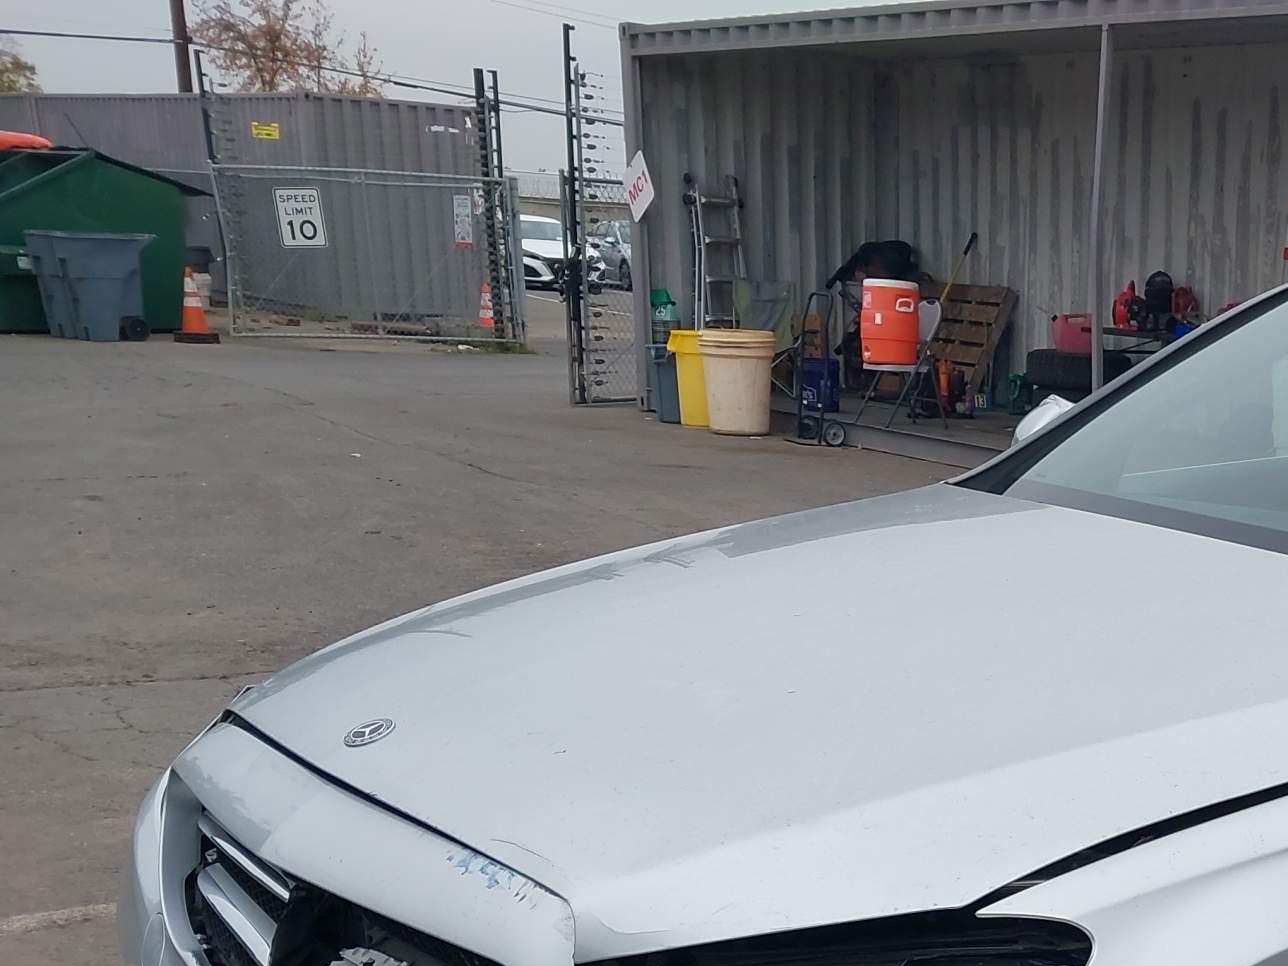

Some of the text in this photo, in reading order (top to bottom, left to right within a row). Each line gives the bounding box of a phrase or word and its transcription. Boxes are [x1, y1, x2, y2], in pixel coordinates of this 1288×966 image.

[628, 170, 648, 206] MC1
[279, 194, 316, 203] SPEED
[284, 206, 313, 216] LIMIT
[287, 219, 318, 241] 10
